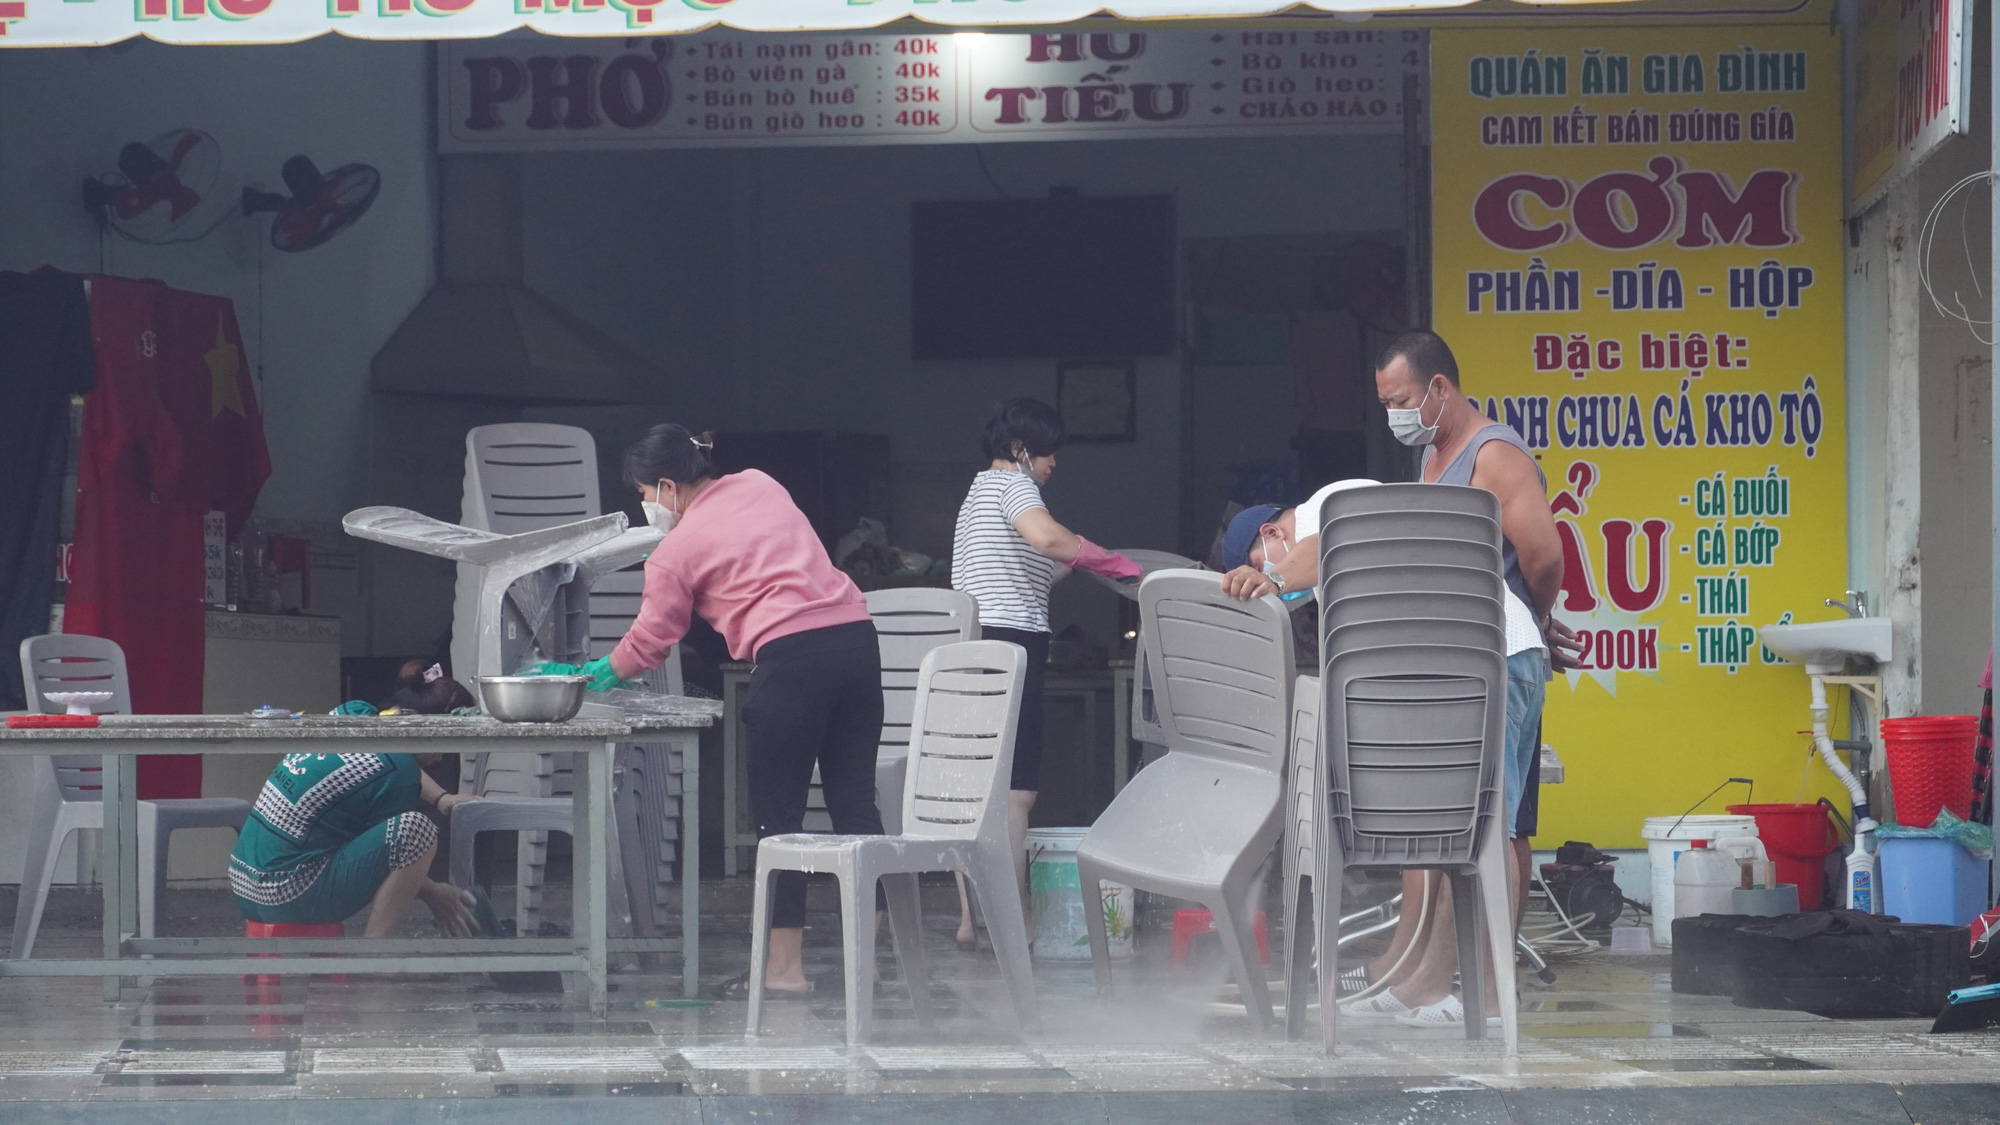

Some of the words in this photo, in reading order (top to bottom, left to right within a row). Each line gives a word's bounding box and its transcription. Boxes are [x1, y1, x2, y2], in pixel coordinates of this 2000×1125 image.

[704, 40, 743, 59] Tái
[756, 43, 812, 61] nạm
[894, 39, 938, 54] 40k
[704, 65, 735, 83] Bò
[749, 65, 804, 83] viên
[817, 63, 846, 84] gà
[896, 63, 940, 78] 40k
[1301, 52, 1357, 69] kho
[1469, 49, 1567, 98] QUÁN
[1581, 48, 1629, 95] ĂN
[1643, 54, 1705, 94] GIA
[1716, 45, 1806, 92] ĐÌNH
[462, 37, 676, 130] PHỞ
[766, 88, 796, 106] bò
[895, 86, 940, 103] 35k
[985, 65, 1193, 124] TIẾU
[766, 112, 804, 132] giò
[819, 111, 865, 129] heo
[895, 110, 940, 126] 40k
[1481, 115, 1542, 145] CAM
[1553, 106, 1598, 144] KẾT
[1607, 109, 1660, 144] BÁN
[1669, 108, 1741, 143] ĐÚNG
[1750, 106, 1795, 142] GÍA
[1473, 155, 1804, 252] CƠM
[1468, 257, 1580, 312] PHẦN
[1729, 260, 1813, 317] HỘP
[1533, 333, 1622, 378] Đặc
[1639, 332, 1748, 378] biệt:
[1557, 395, 1646, 449] CHUA
[1653, 378, 1698, 447] CÁ
[1704, 392, 1773, 446] KHO
[1779, 376, 1823, 458] TỘ
[1696, 473, 1727, 517] CÁ
[1733, 466, 1789, 516] ĐUỐI
[1550, 461, 1668, 612] ẨU
[1696, 522, 1727, 566] CÁ
[1735, 521, 1779, 566] BỚP
[1696, 572, 1748, 614] THÁI
[1696, 621, 1755, 672] THẬP
